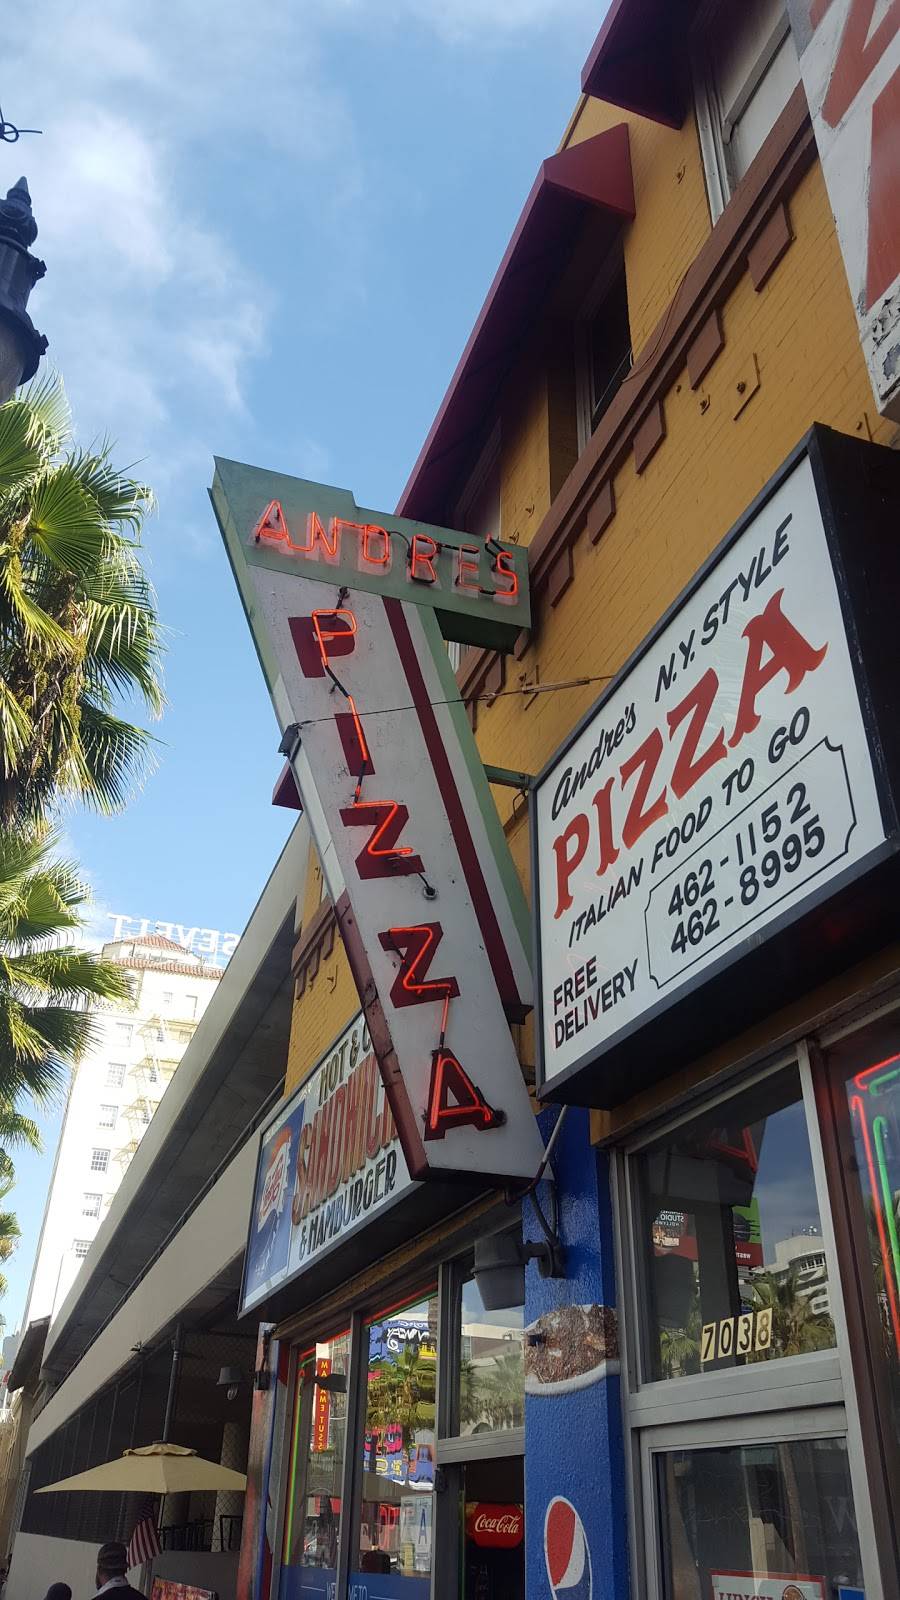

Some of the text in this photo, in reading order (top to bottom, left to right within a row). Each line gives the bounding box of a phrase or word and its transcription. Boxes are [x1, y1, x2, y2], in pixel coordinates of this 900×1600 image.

[552, 513, 793, 821] Andre's N.Y. STYLE
[553, 588, 829, 920] PIZZA
[287, 609, 508, 1141] PIZZA
[568, 706, 811, 948] ITALIAN FOOD TO GO
[668, 782, 811, 917] 462-1152
[671, 815, 825, 954] 462-8995
[553, 956, 597, 1015] FREE
[554, 959, 638, 1049] DELIVERY
[318, 1038, 349, 1107] HOT
[306, 1150, 397, 1254] HAMBURGER
[703, 1311, 770, 1360] 7038
